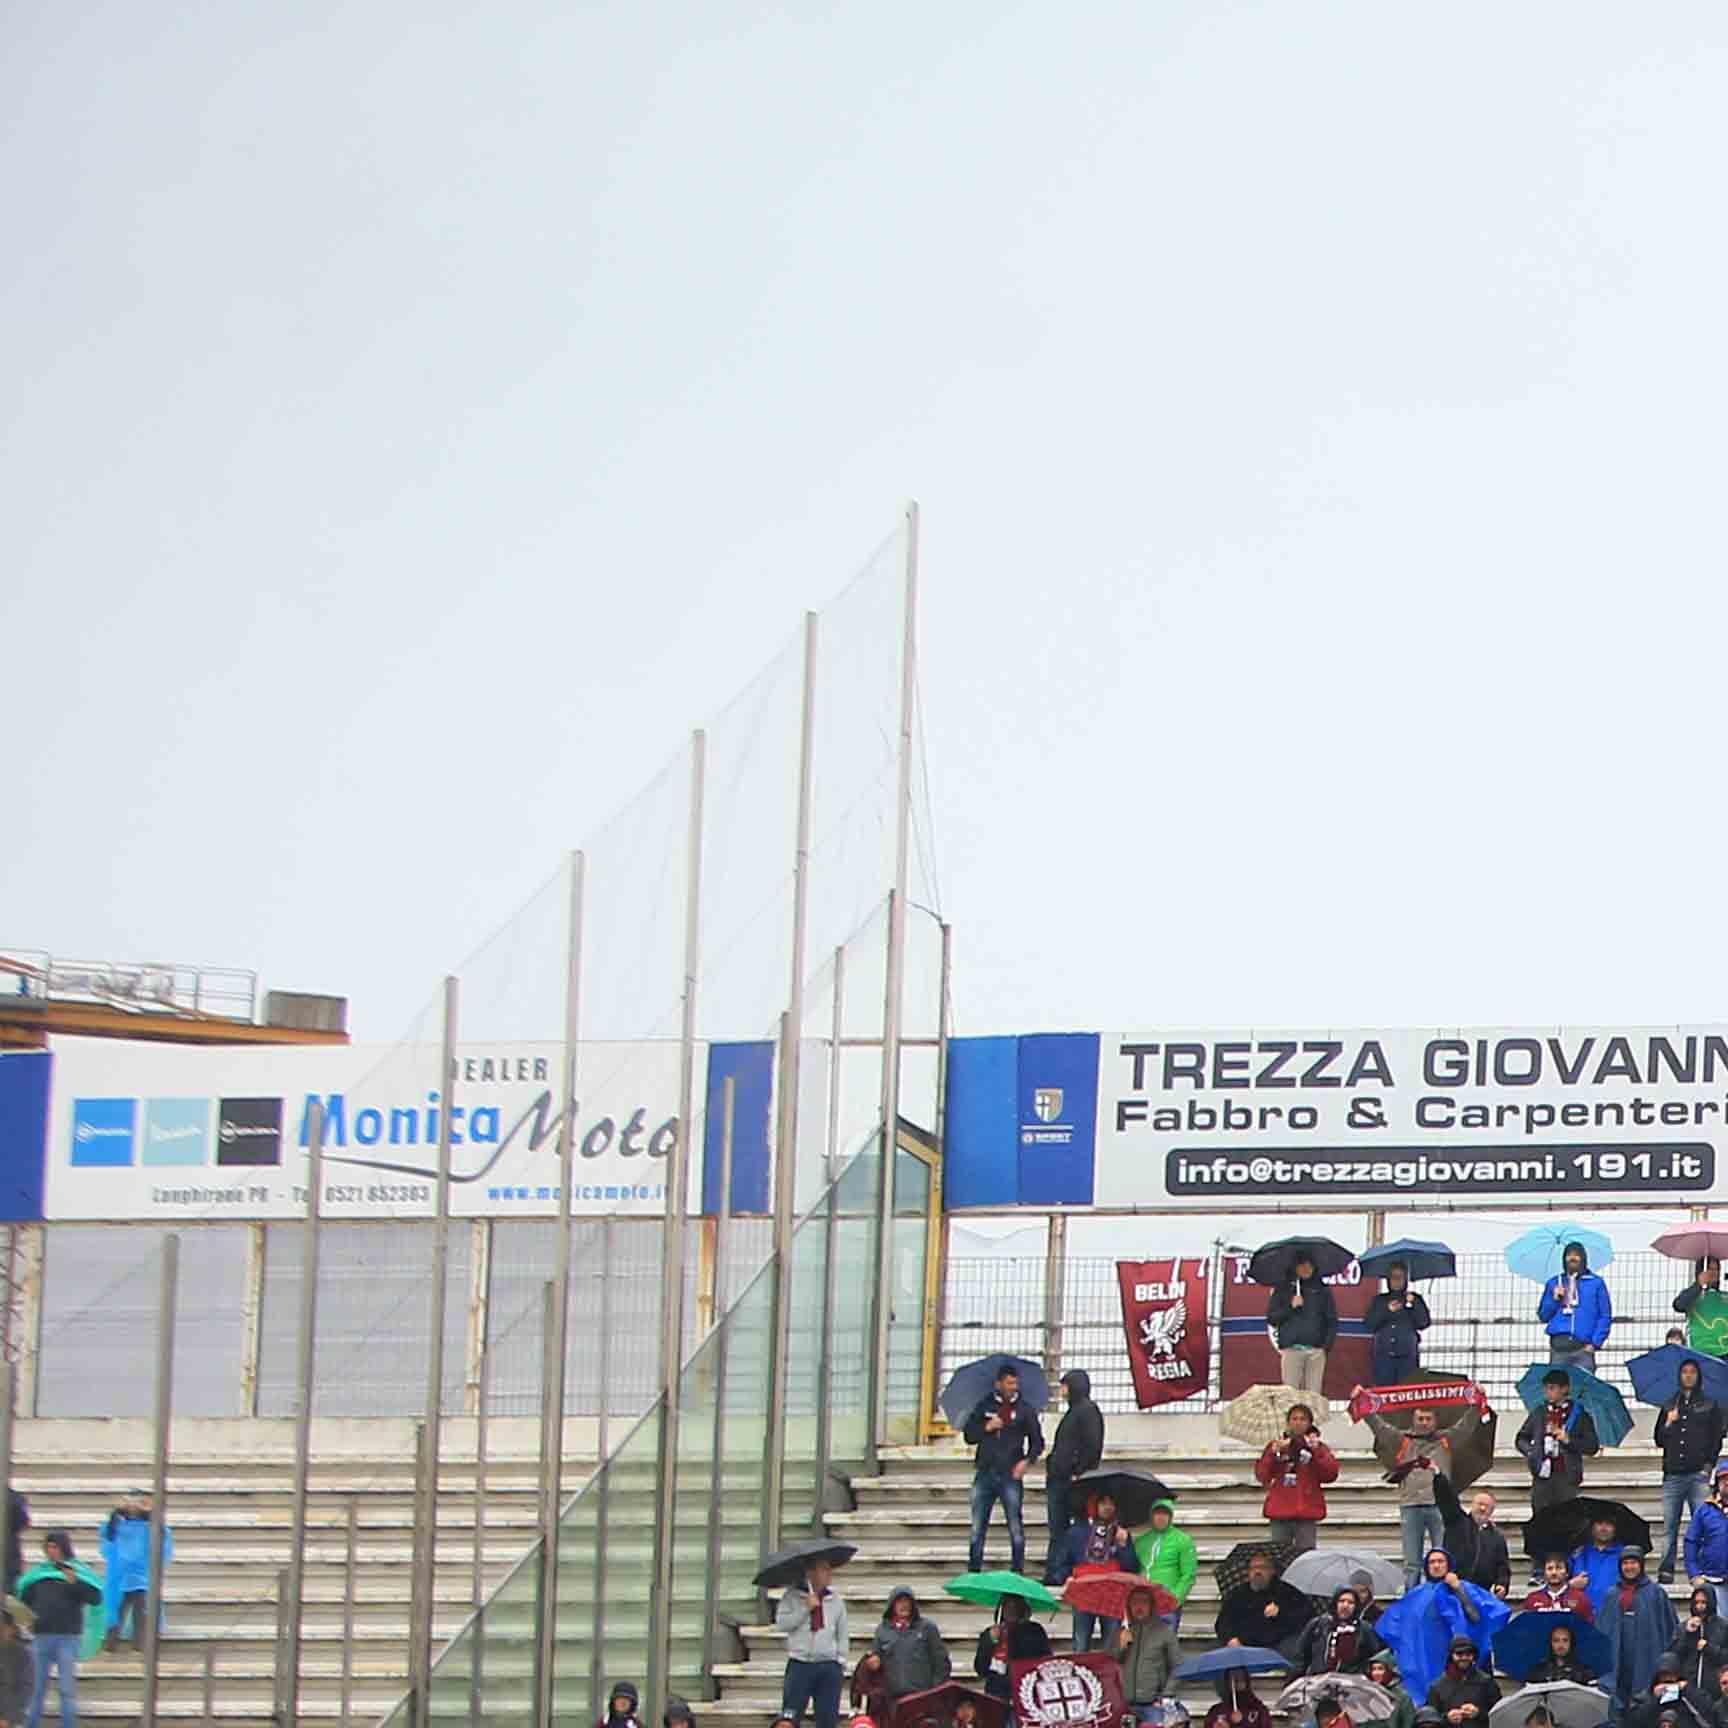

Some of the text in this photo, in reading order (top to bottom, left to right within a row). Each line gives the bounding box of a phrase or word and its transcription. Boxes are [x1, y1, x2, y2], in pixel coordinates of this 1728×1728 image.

[1119, 1039, 1395, 1090] TREZZA
[300, 1089, 681, 1158] Monica Moto
[1116, 1100, 1320, 1132] Fabbro
[1346, 1098, 1389, 1130] &
[1178, 1153, 1703, 1187] info@trezzagiovanni.191.it
